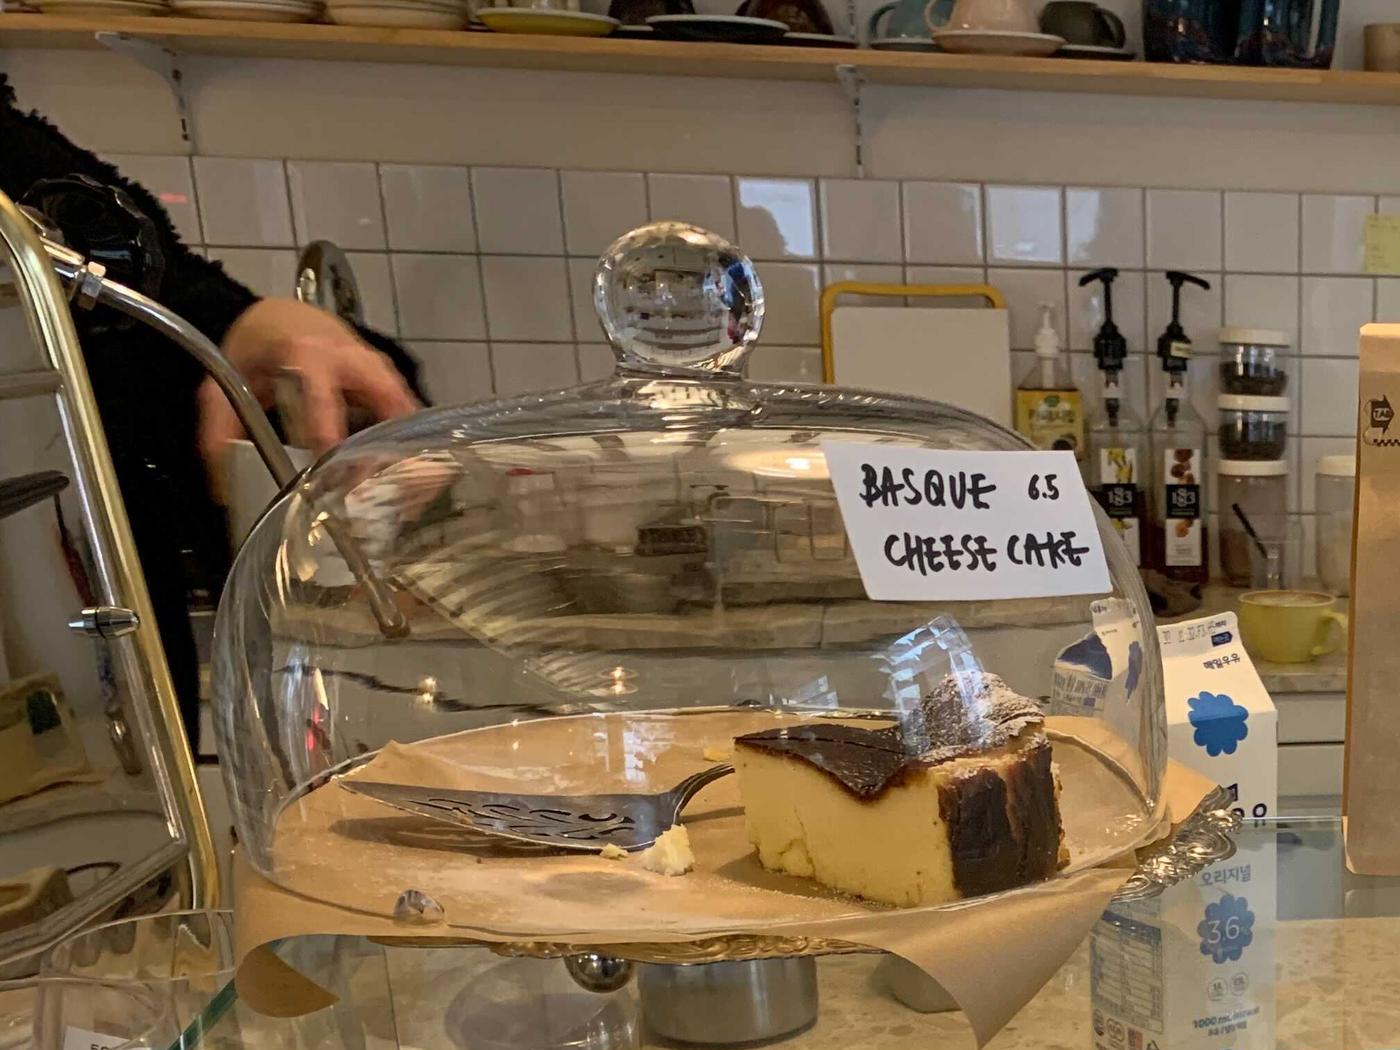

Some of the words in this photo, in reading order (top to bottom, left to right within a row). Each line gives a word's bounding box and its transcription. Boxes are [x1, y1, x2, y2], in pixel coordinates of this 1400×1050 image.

[859, 463, 997, 510] BASQUE
[1028, 473, 1060, 501] 6.5
[884, 532, 997, 576] CHEESE
[1007, 531, 1090, 569] CAKE
[1201, 865, 1252, 887] 오리지널
